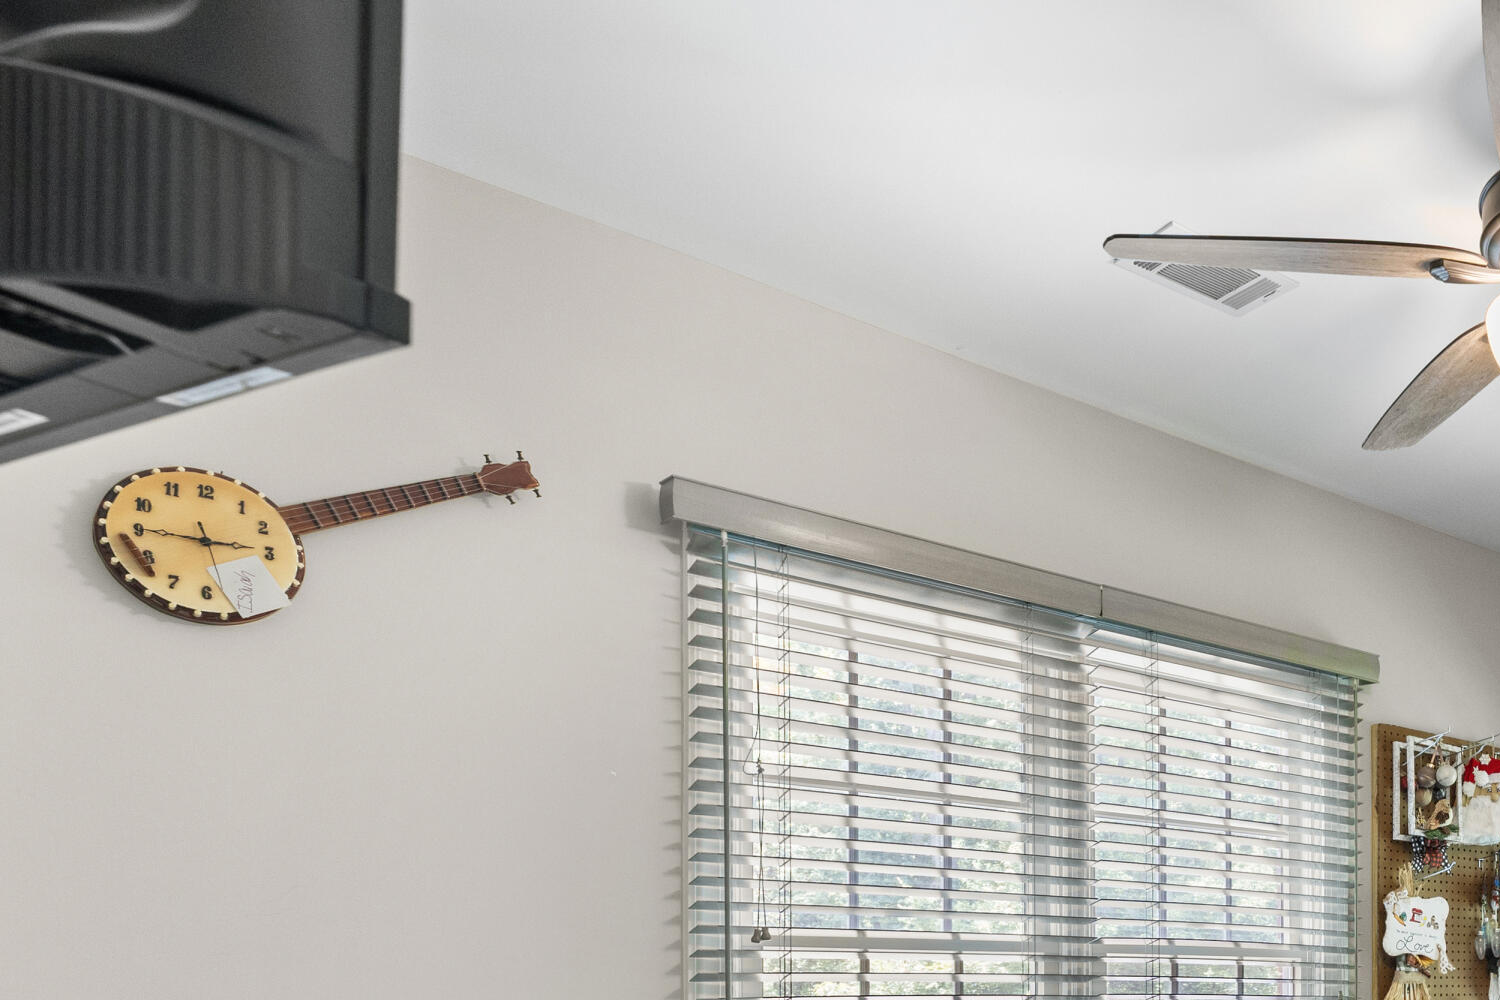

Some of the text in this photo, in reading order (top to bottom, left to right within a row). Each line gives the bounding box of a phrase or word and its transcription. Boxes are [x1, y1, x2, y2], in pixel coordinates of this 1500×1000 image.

[164, 482, 179, 497] 11
[196, 484, 215, 500] 12
[134, 496, 153, 513] 10
[237, 500, 245, 515] 1
[133, 523, 145, 537] 9
[257, 520, 269, 535] 2
[264, 545, 276, 561] 3
[167, 574, 180, 590] 7
[201, 585, 213, 600] 6
[1396, 935, 1434, 954] Love
